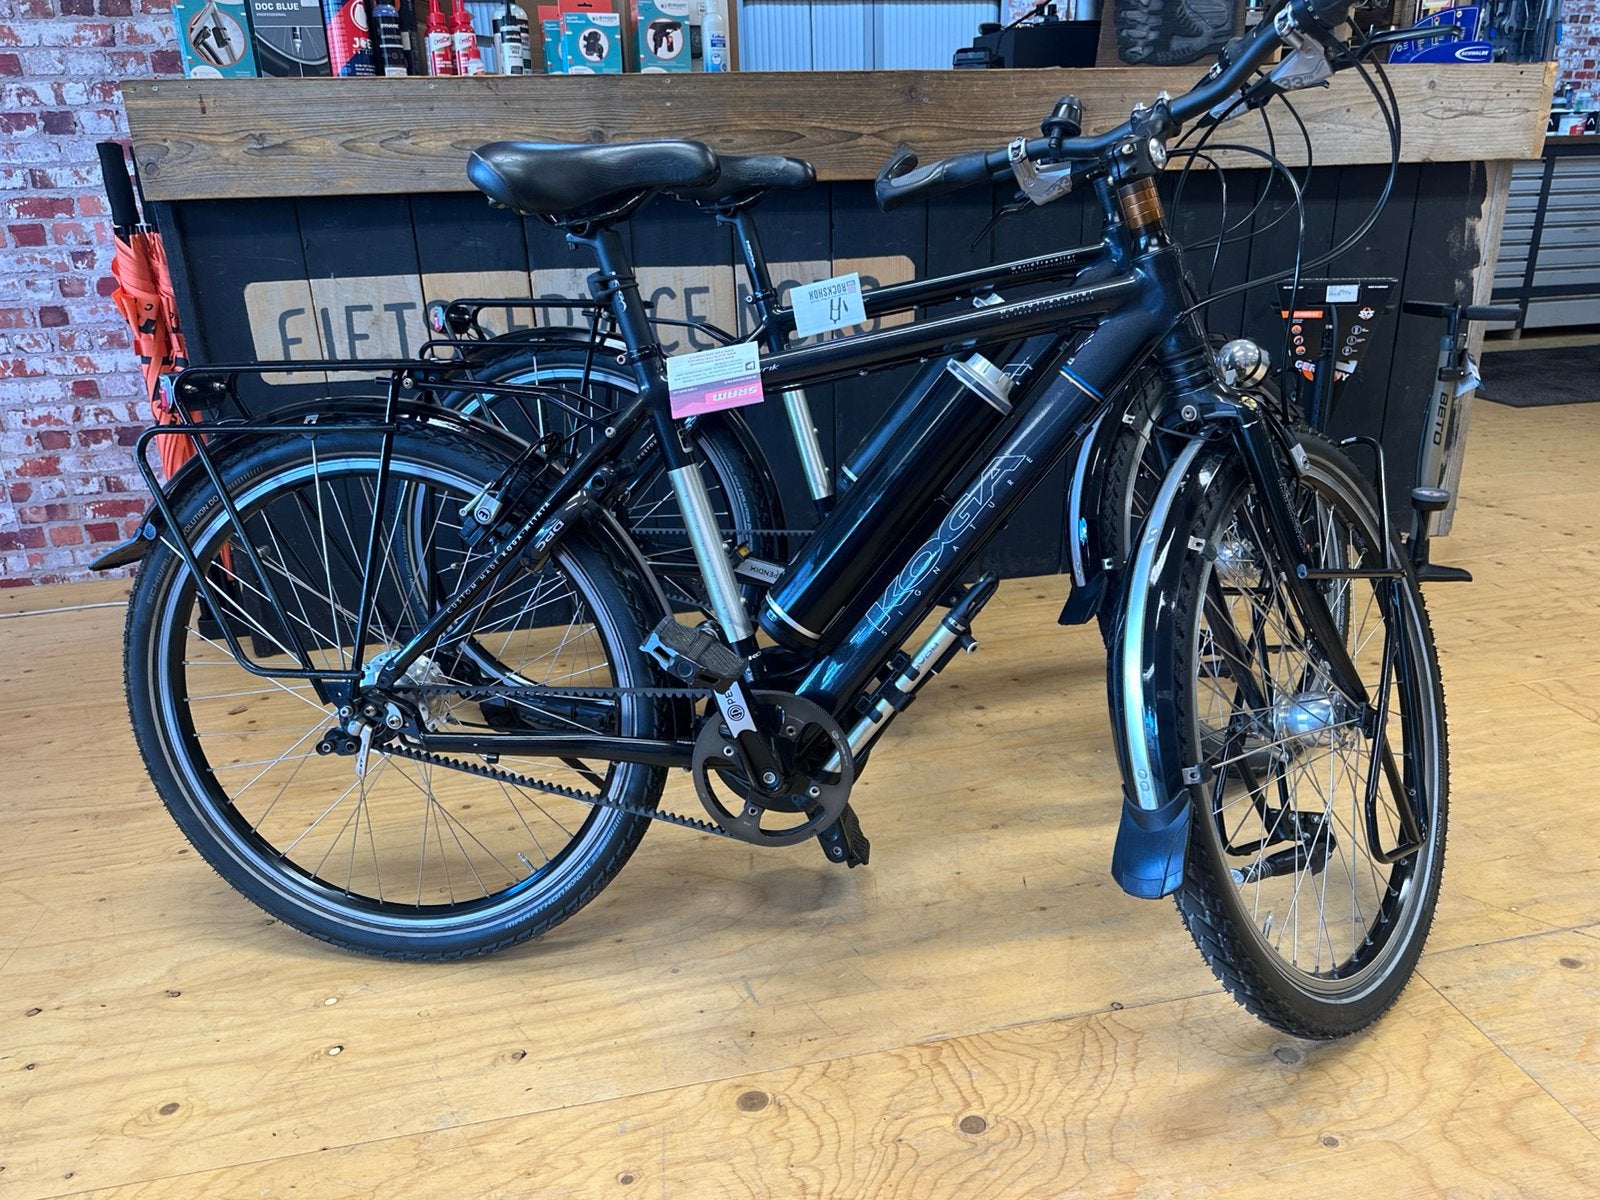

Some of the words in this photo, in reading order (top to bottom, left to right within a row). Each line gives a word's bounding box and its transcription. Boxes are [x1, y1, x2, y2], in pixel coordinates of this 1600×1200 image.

[255, 2, 273, 11] DOC
[276, 2, 299, 11] BLUE
[808, 281, 848, 301] ROCKSHOX
[712, 385, 758, 402] SRAM
[1433, 391, 1449, 446] BETO
[864, 454, 1027, 632] KOGA
[880, 455, 1034, 638] SIGNATURE
[446, 580, 478, 614] CUSTOM
[479, 558, 500, 582] MADE
[563, 863, 592, 892] MONDIAL
